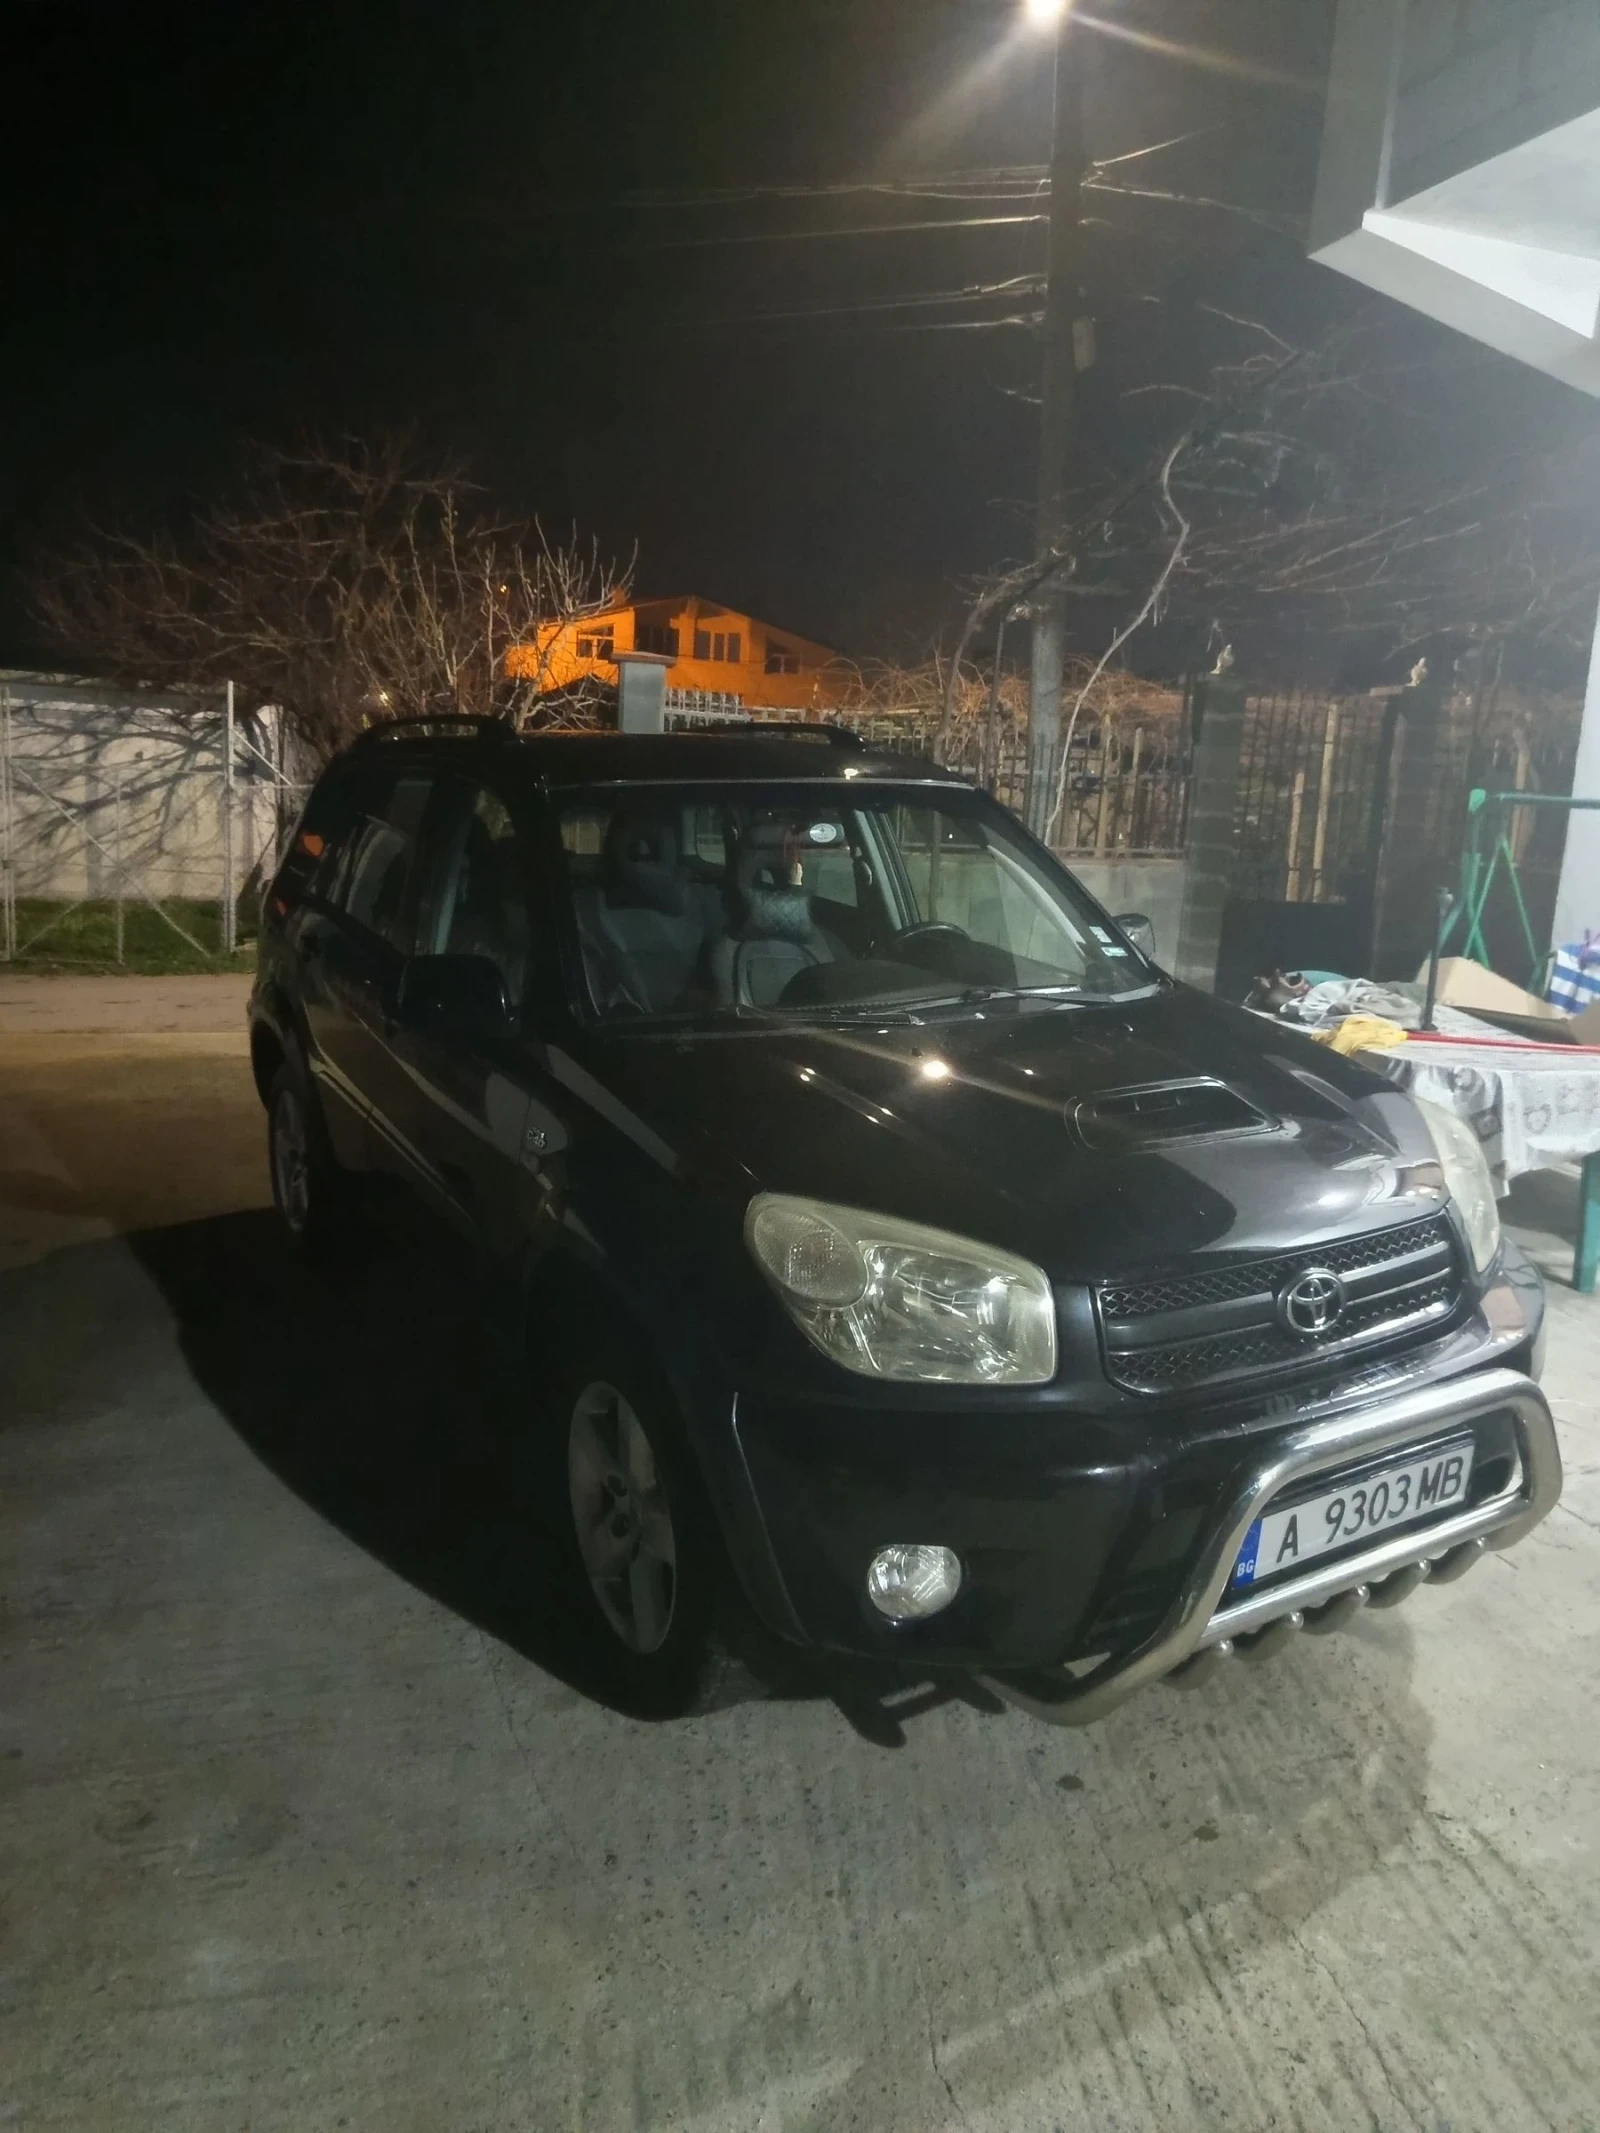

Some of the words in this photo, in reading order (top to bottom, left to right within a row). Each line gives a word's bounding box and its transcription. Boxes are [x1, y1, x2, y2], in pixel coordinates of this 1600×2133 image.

[1276, 1514, 1299, 1564] A
[1325, 1473, 1411, 1545] 9303
[1415, 1455, 1464, 1511] MB
[1237, 1559, 1254, 1577] BG
